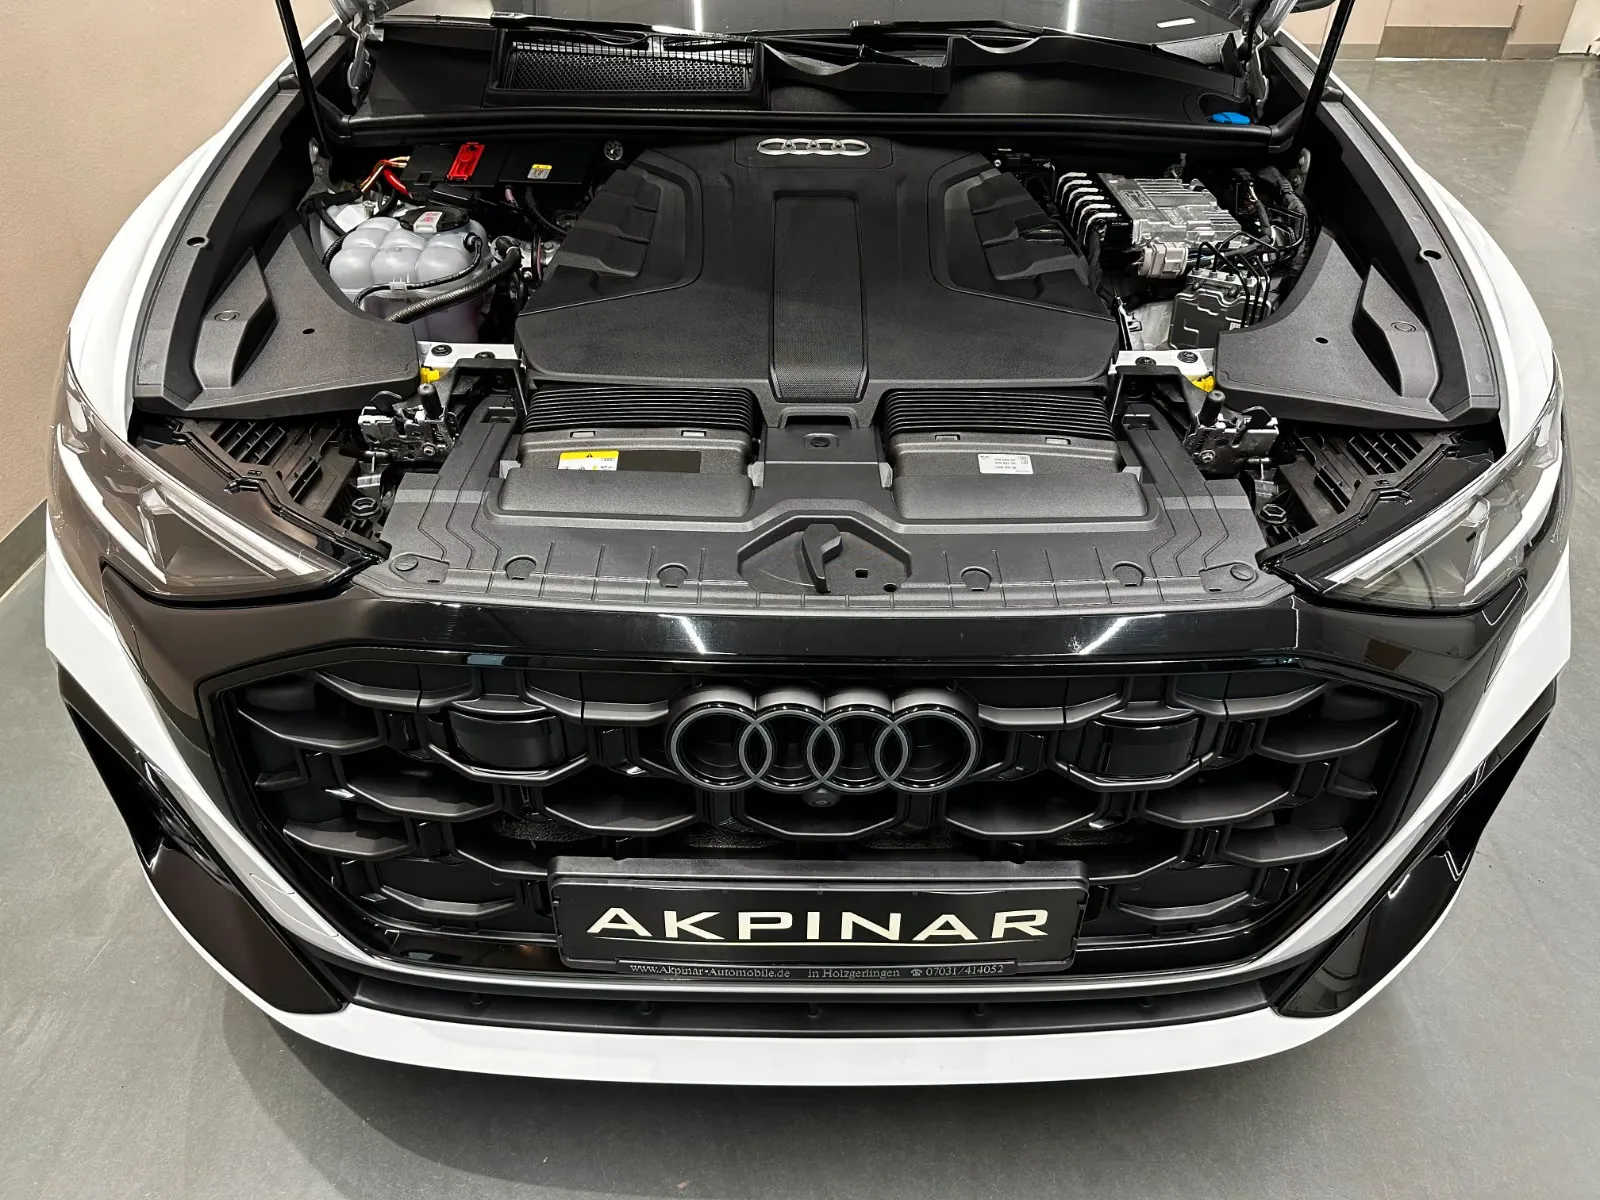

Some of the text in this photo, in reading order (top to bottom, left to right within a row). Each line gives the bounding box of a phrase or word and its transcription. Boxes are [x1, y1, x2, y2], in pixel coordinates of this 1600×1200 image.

[587, 907, 1049, 941] AKPINAR
[630, 964, 1004, 980] www.Akpinar-Automobile.de in Holzgerlingen 07031/414052
